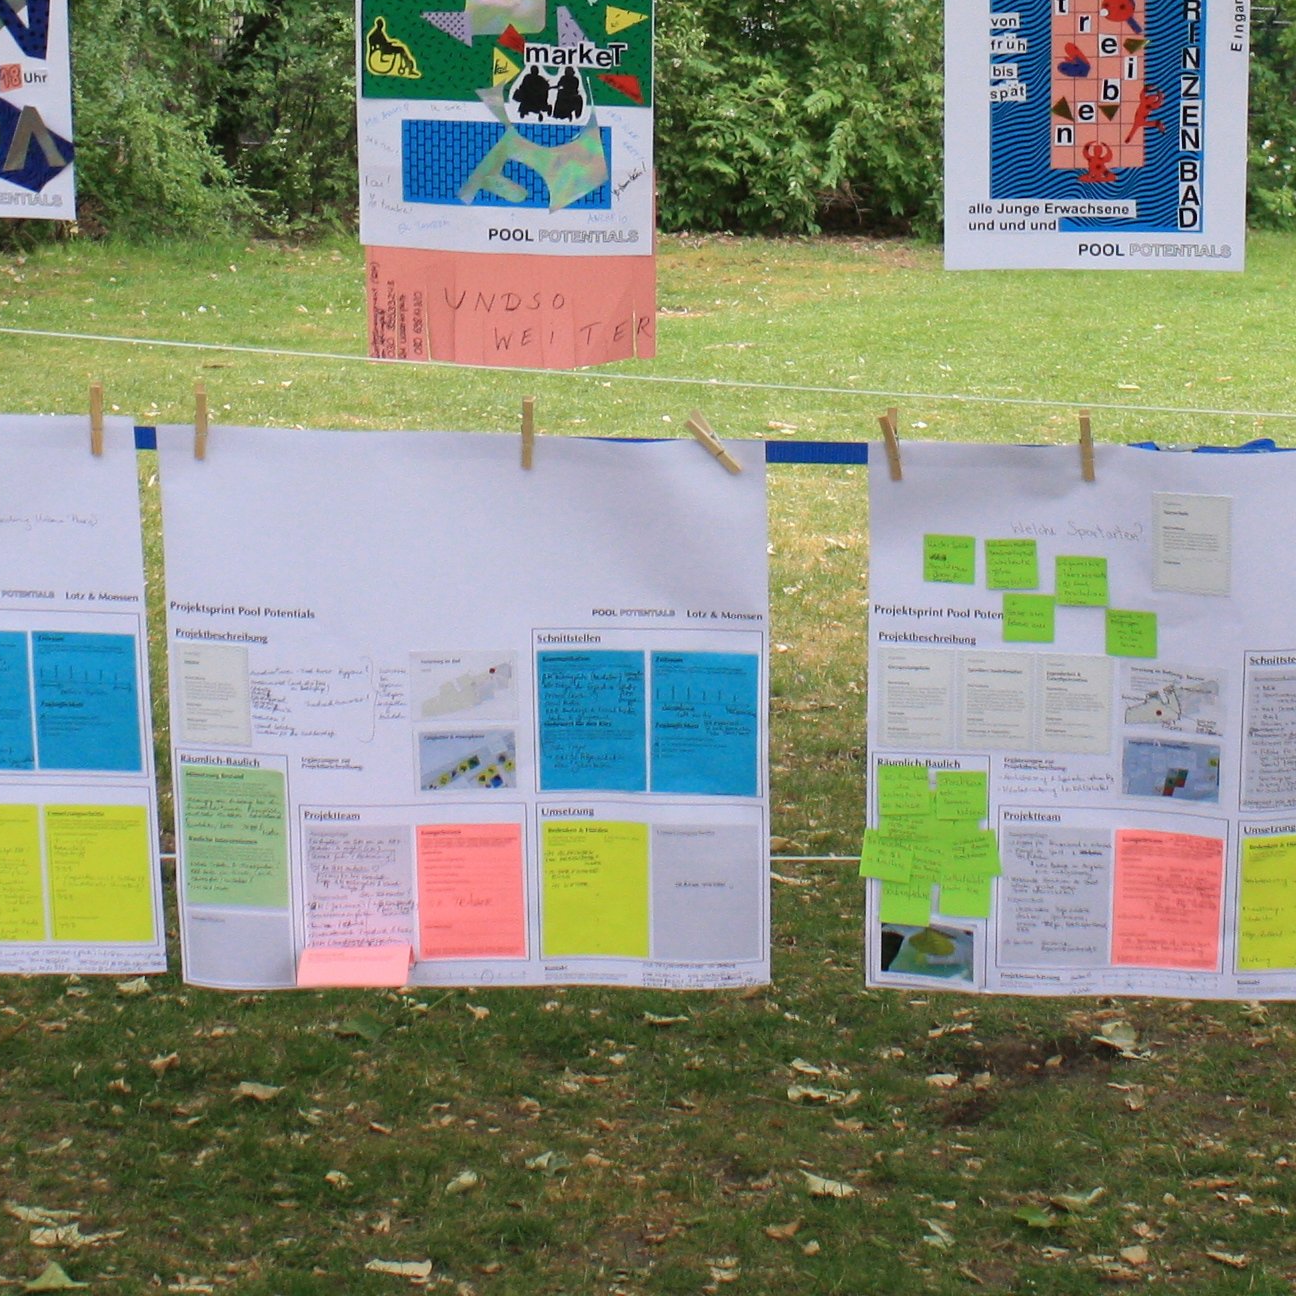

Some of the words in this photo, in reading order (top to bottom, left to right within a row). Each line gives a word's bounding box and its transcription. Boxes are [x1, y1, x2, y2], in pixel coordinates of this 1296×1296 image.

[991, 17, 1017, 27] von
[990, 35, 1026, 51] früh
[24, 71, 48, 84] Uhr
[992, 65, 1015, 77] bis
[990, 82, 1026, 99] spät
[968, 202, 992, 214] alle
[996, 202, 1040, 217] Junge
[1044, 203, 1129, 215] Erwachsene
[968, 219, 995, 231] und
[998, 219, 1026, 231] und
[1029, 219, 1057, 231] und
[488, 228, 534, 242] POOL
[538, 229, 639, 243] POTENTIALS
[1078, 243, 1124, 257] POOL
[1129, 243, 1232, 258] POTENTIALS
[170, 601, 235, 616] Projektsprint
[238, 606, 260, 616] Pool
[264, 607, 315, 618] Potentials
[710, 611, 718, 619] &
[874, 604, 944, 618] Projektsprint
[947, 608, 970, 618] Pool
[176, 628, 268, 644] Projektbeschreibung
[537, 634, 601, 643] Schnittstellen
[878, 631, 977, 645] Projektbeschreibung
[180, 754, 260, 767] Räumlich-Baulich
[304, 811, 360, 821] Projektteam
[541, 807, 595, 817] Umsetzung
[1004, 811, 1061, 822] Projektteam
[1243, 824, 1296, 835] Umsetzung
